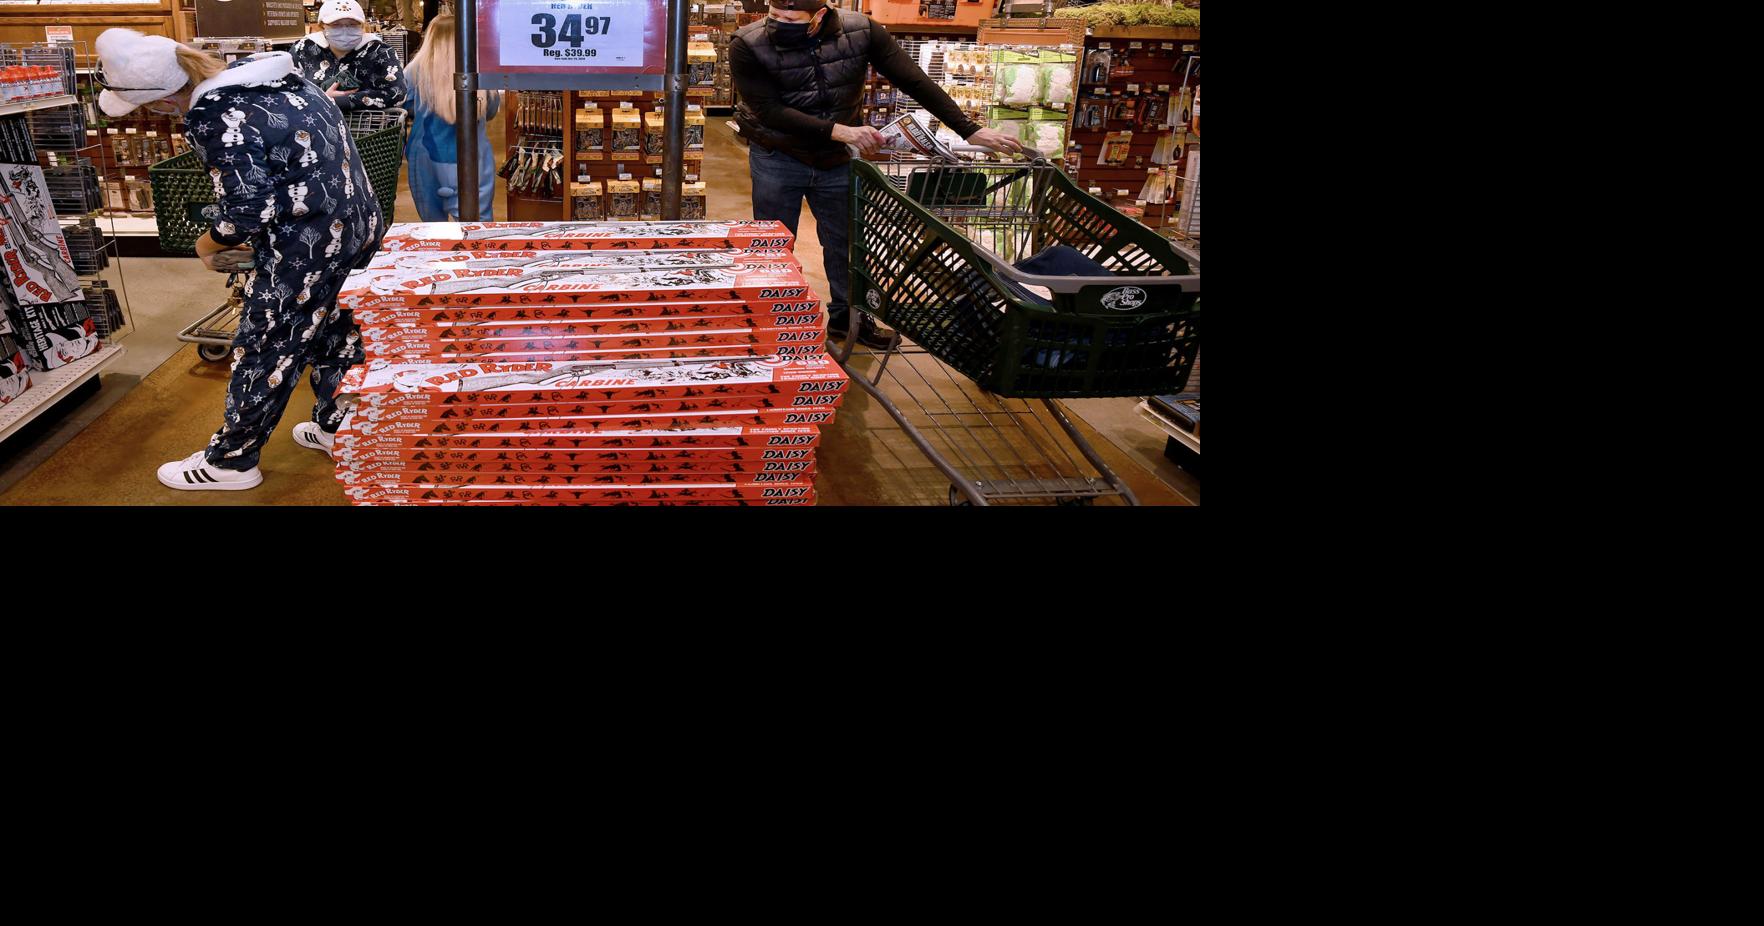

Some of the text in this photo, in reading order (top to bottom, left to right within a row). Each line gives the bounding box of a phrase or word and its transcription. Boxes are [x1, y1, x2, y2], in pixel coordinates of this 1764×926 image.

[531, 13, 610, 48] 34 97
[543, 49, 596, 57] Reg. $39.99
[482, 221, 544, 229] RYDER
[750, 238, 790, 248] DAISY
[56, 235, 71, 264] CARBINE
[471, 251, 536, 259] RYDER
[4, 249, 30, 287] RYDER
[400, 268, 523, 289] RED RYDER
[26, 281, 52, 302] RED
[523, 283, 604, 292] CARBINE
[759, 288, 804, 298] DAISY
[381, 295, 405, 303] RYDER
[24, 305, 37, 319] KIT
[771, 302, 815, 312] DAISY
[775, 314, 818, 326] DAISY
[29, 319, 48, 352] HERITAGE
[777, 331, 820, 342] DAISY
[776, 345, 819, 355] DAISY
[425, 362, 553, 386] RED RYDER
[555, 378, 638, 388] CARBINE
[799, 381, 844, 392] DAISY
[792, 395, 838, 406] DAISY
[402, 407, 428, 415] RYDER
[784, 412, 830, 423] DAISY
[395, 421, 420, 429] RYDER
[377, 435, 402, 443] RYDER
[767, 435, 815, 445] DAISY
[762, 450, 808, 459] DAISY
[763, 462, 810, 471] DAISY
[754, 472, 800, 482] DAISY
[762, 488, 808, 497] DAISY
